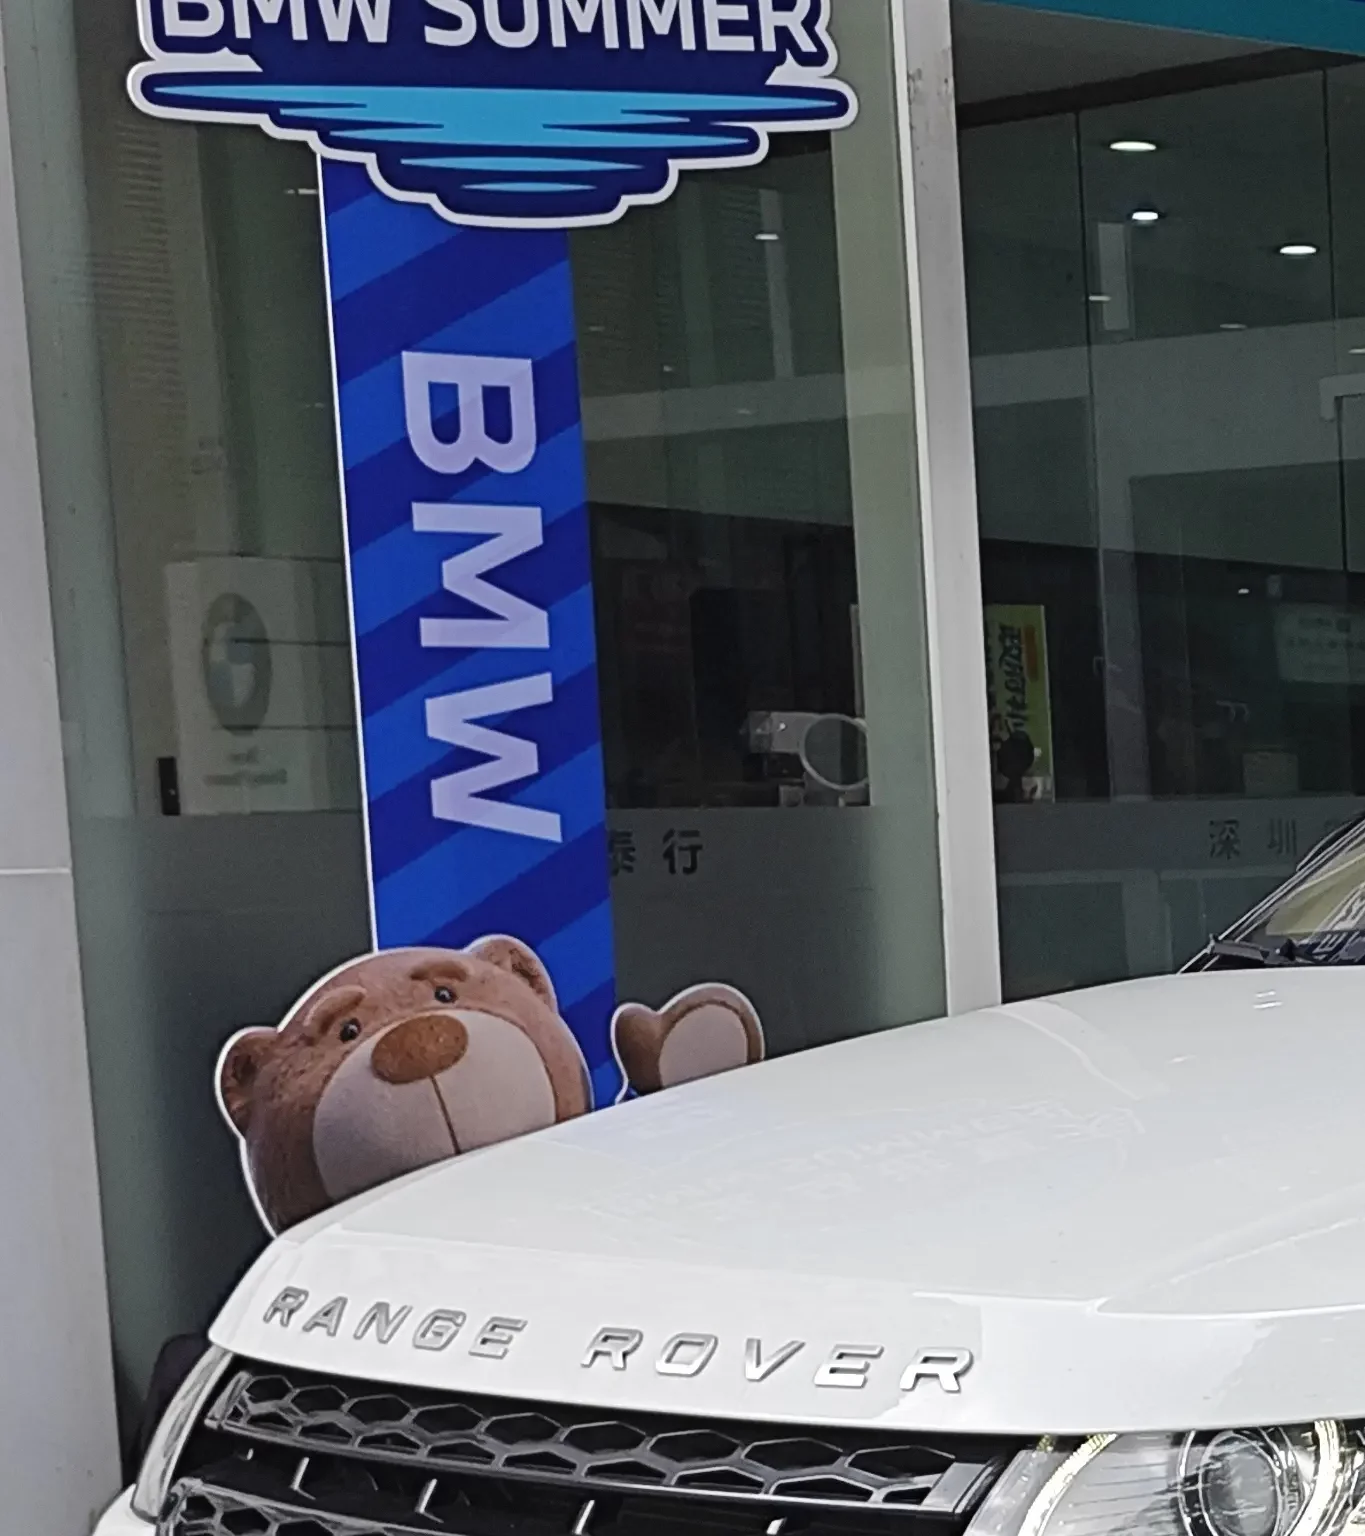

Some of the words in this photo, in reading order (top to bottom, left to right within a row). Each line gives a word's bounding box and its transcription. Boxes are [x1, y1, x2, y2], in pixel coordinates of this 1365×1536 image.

[162, 0, 392, 43] BMW
[424, 0, 816, 53] SUMMER
[401, 350, 563, 843] BMW
[1208, 816, 1352, 861] 深圳
[262, 1285, 528, 1358] RANGE
[580, 1326, 974, 1393] ROVER
